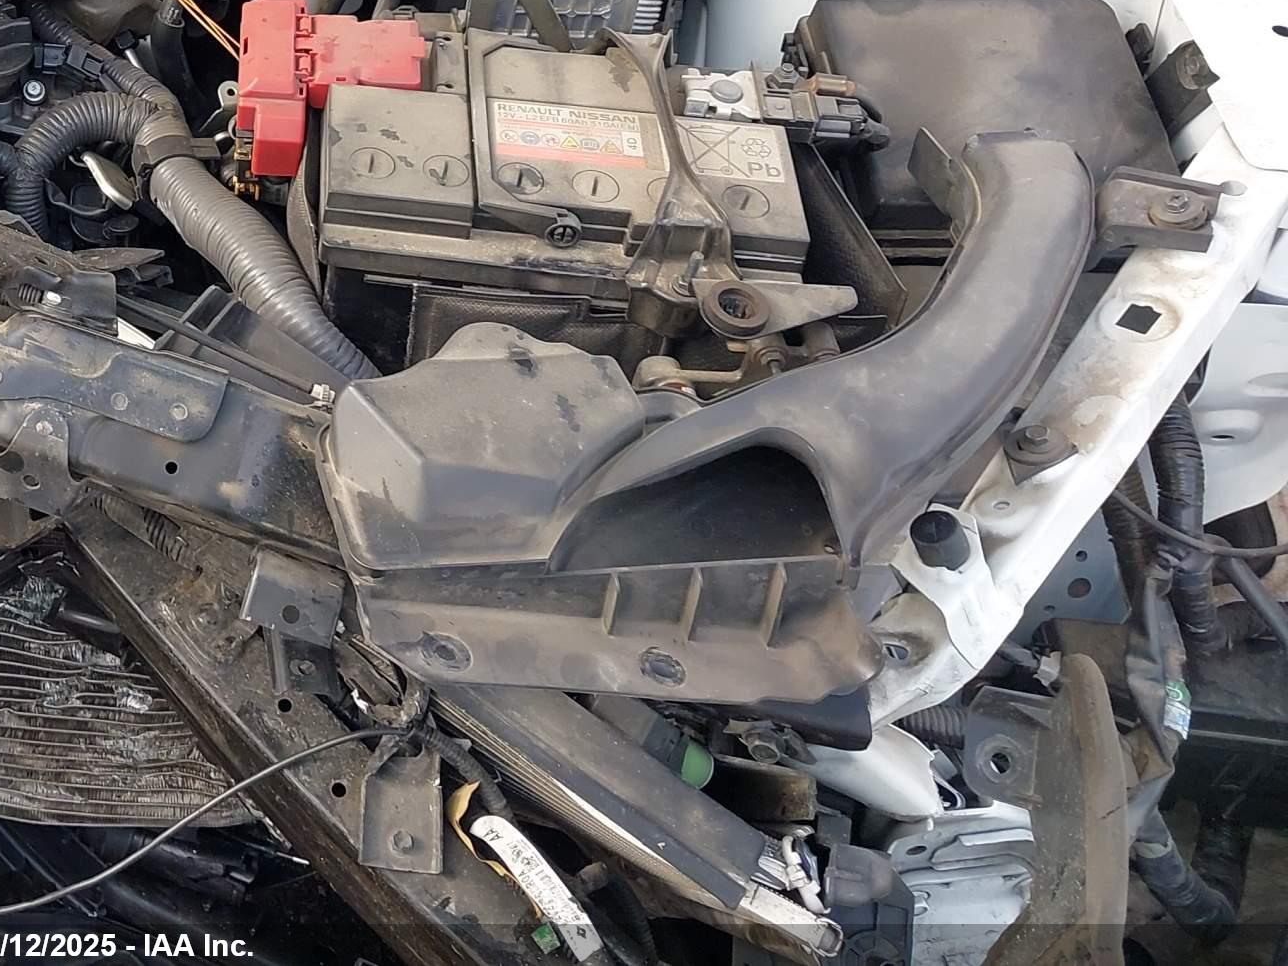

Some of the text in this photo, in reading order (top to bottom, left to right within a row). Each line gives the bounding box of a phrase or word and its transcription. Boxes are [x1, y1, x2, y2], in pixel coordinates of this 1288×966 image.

[497, 103, 635, 124] RENAULT NISSAN
[748, 161, 781, 178] Pb
